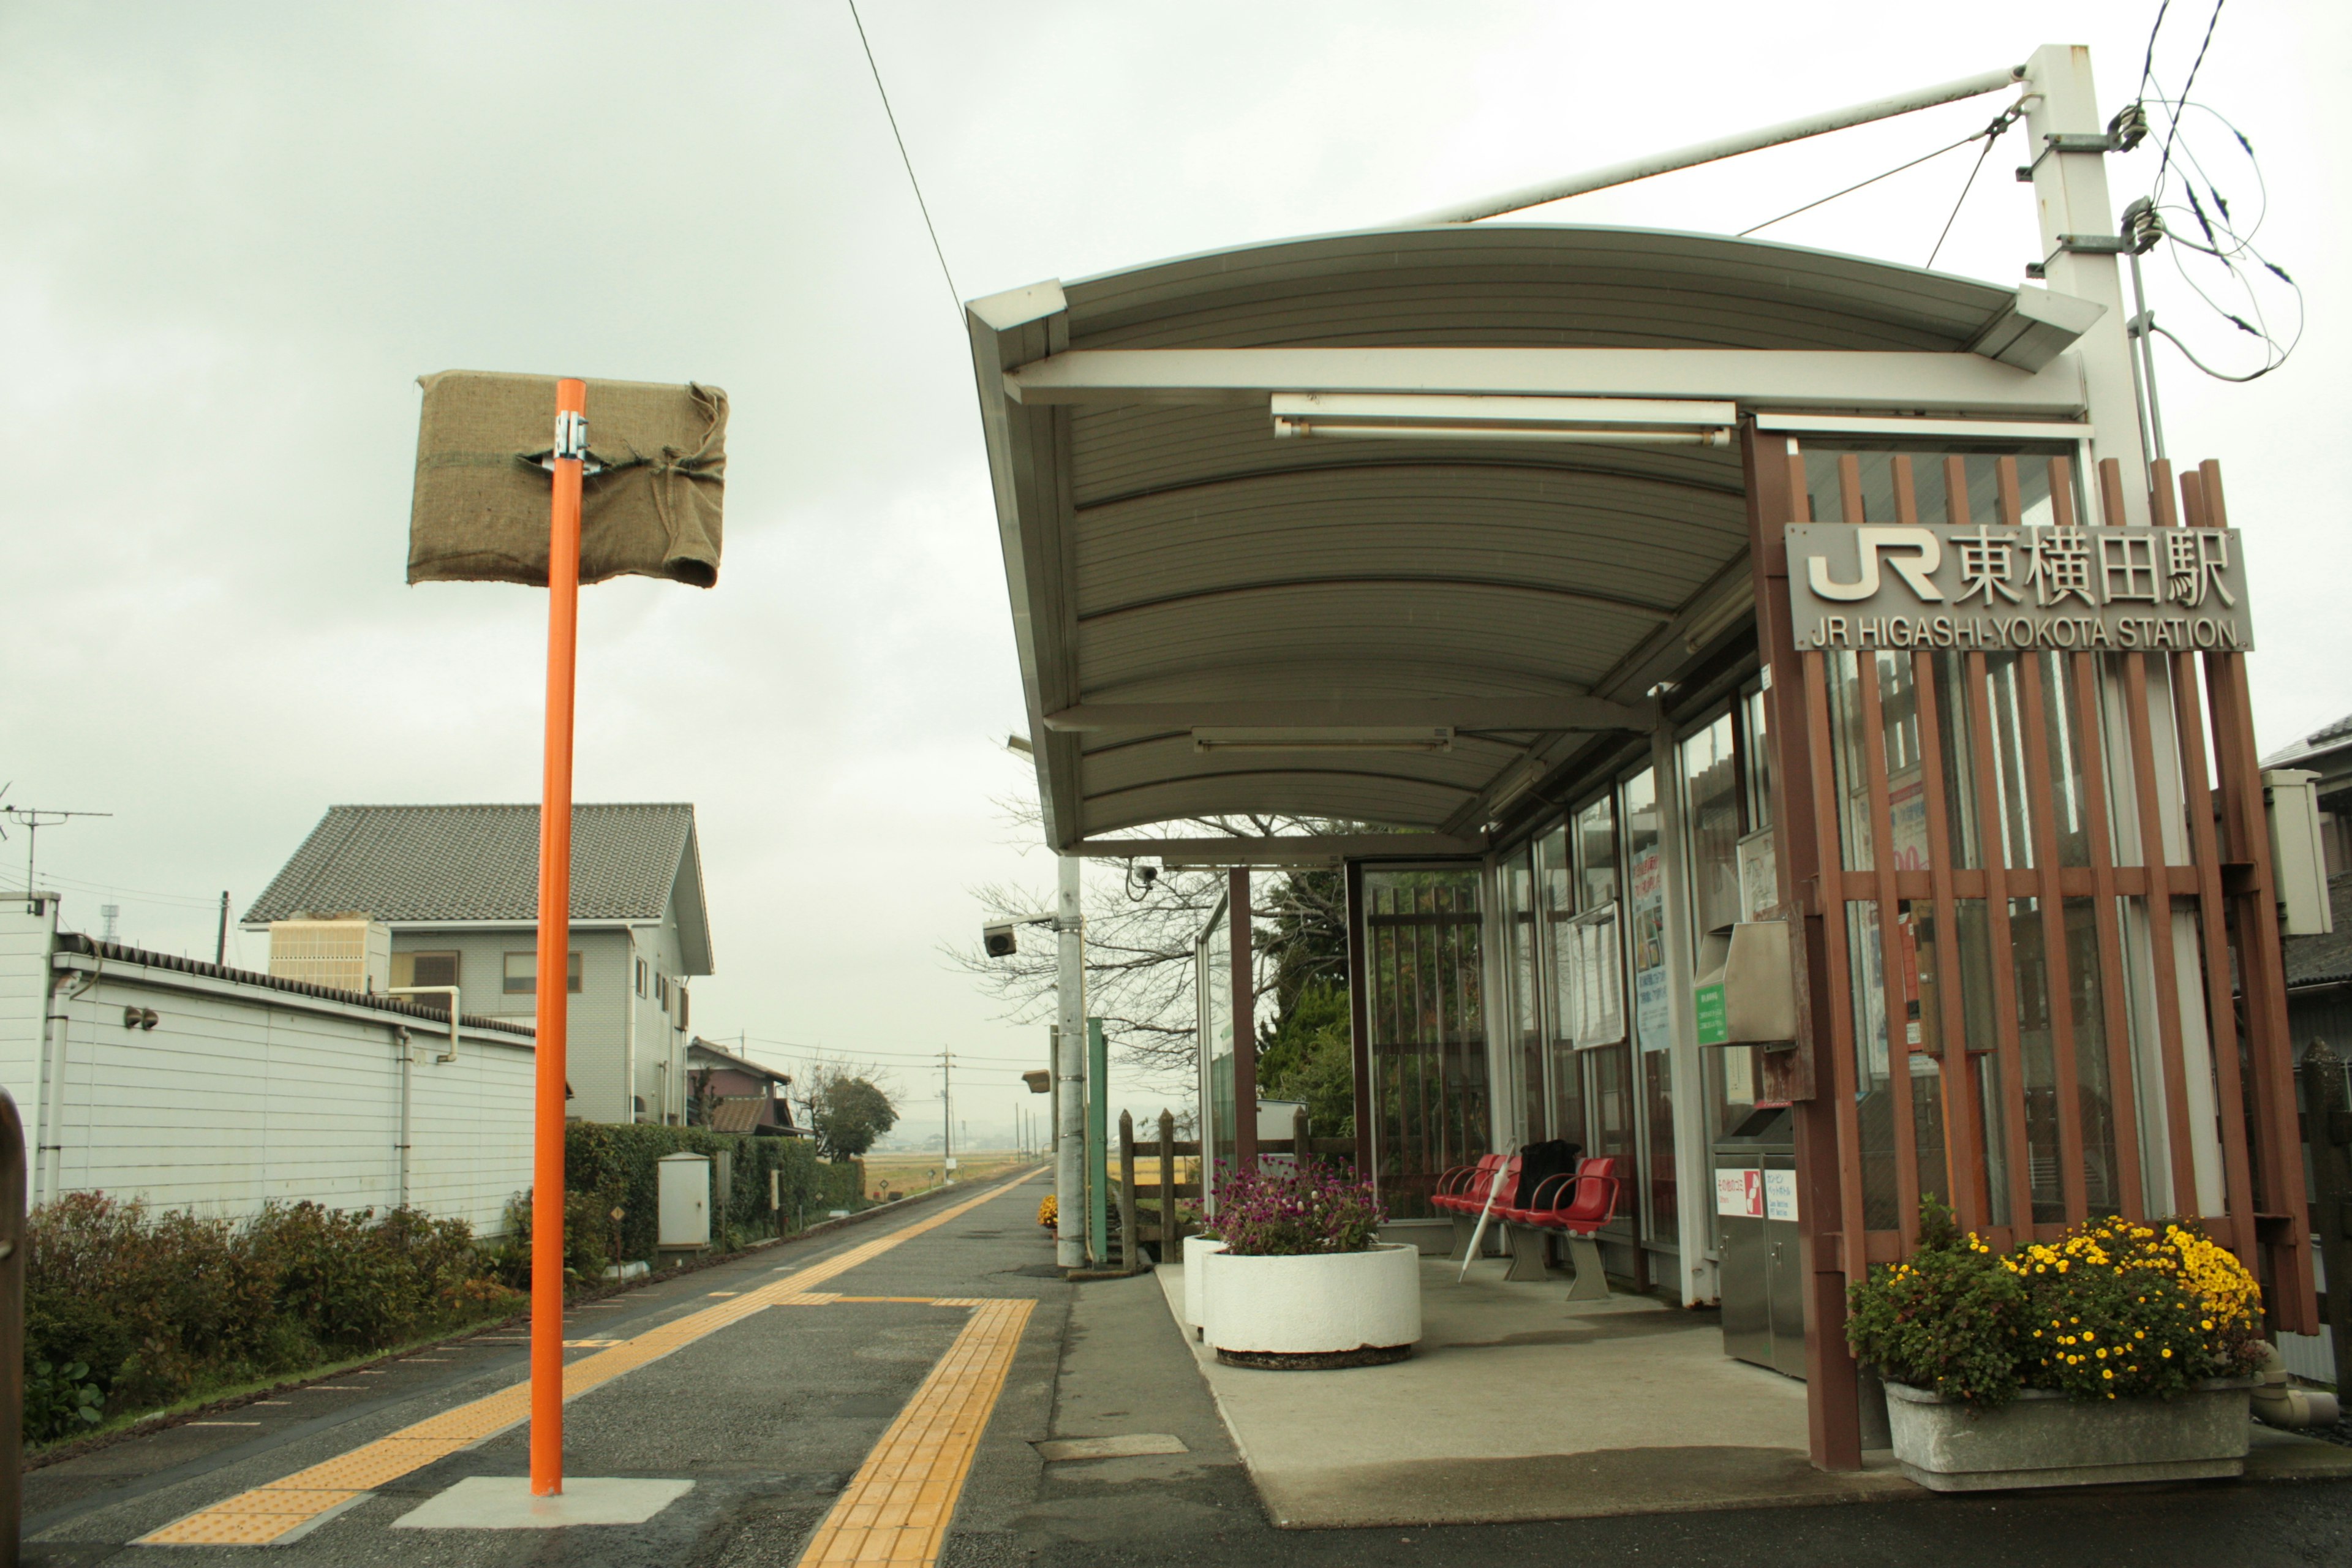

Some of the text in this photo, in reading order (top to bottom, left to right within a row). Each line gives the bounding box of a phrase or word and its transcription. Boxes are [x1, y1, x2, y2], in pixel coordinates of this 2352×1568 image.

[1807, 524, 2236, 608] JR 東横田駅
[1812, 615, 2237, 648] JR HIGASHI-YOKOTA STATION
